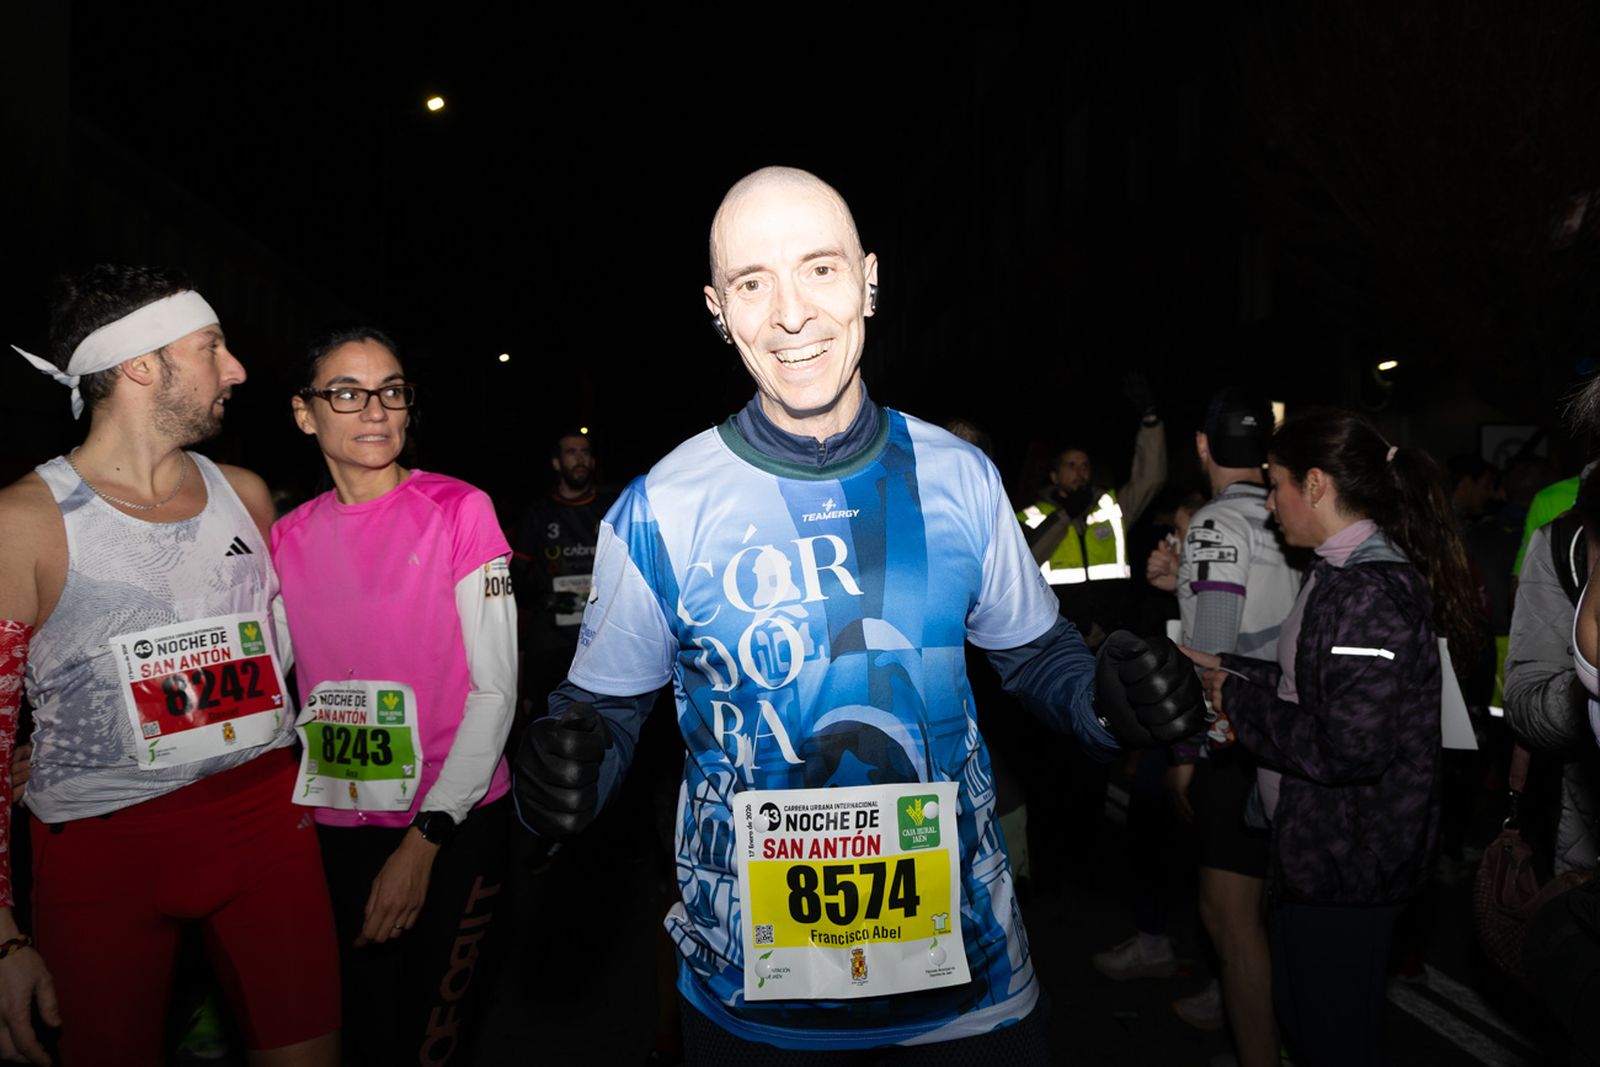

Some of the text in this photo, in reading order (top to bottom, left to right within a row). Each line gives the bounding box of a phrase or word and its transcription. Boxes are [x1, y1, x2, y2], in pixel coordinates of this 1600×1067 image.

[802, 509, 860, 523] TEAMERGY
[547, 522, 560, 539] 3
[677, 524, 864, 627] CÓR
[157, 630, 228, 656] NOCHE DE
[692, 617, 805, 692] DO
[140, 658, 175, 678] SAN
[179, 646, 232, 670] ANTÓN
[162, 661, 265, 717] 8242
[319, 694, 353, 706] NOCHE
[354, 695, 367, 707] DE
[332, 708, 367, 724] ANTÓN
[322, 724, 393, 766] 8243
[783, 800, 878, 812] CARRERA URBANA INTERNACIONAL
[785, 809, 880, 832] NOCHE DE
[762, 830, 881, 859] SAN ANTÓN
[902, 829, 917, 837] CAJA
[786, 857, 920, 926] 8574
[810, 925, 902, 945] Francisco Abel
